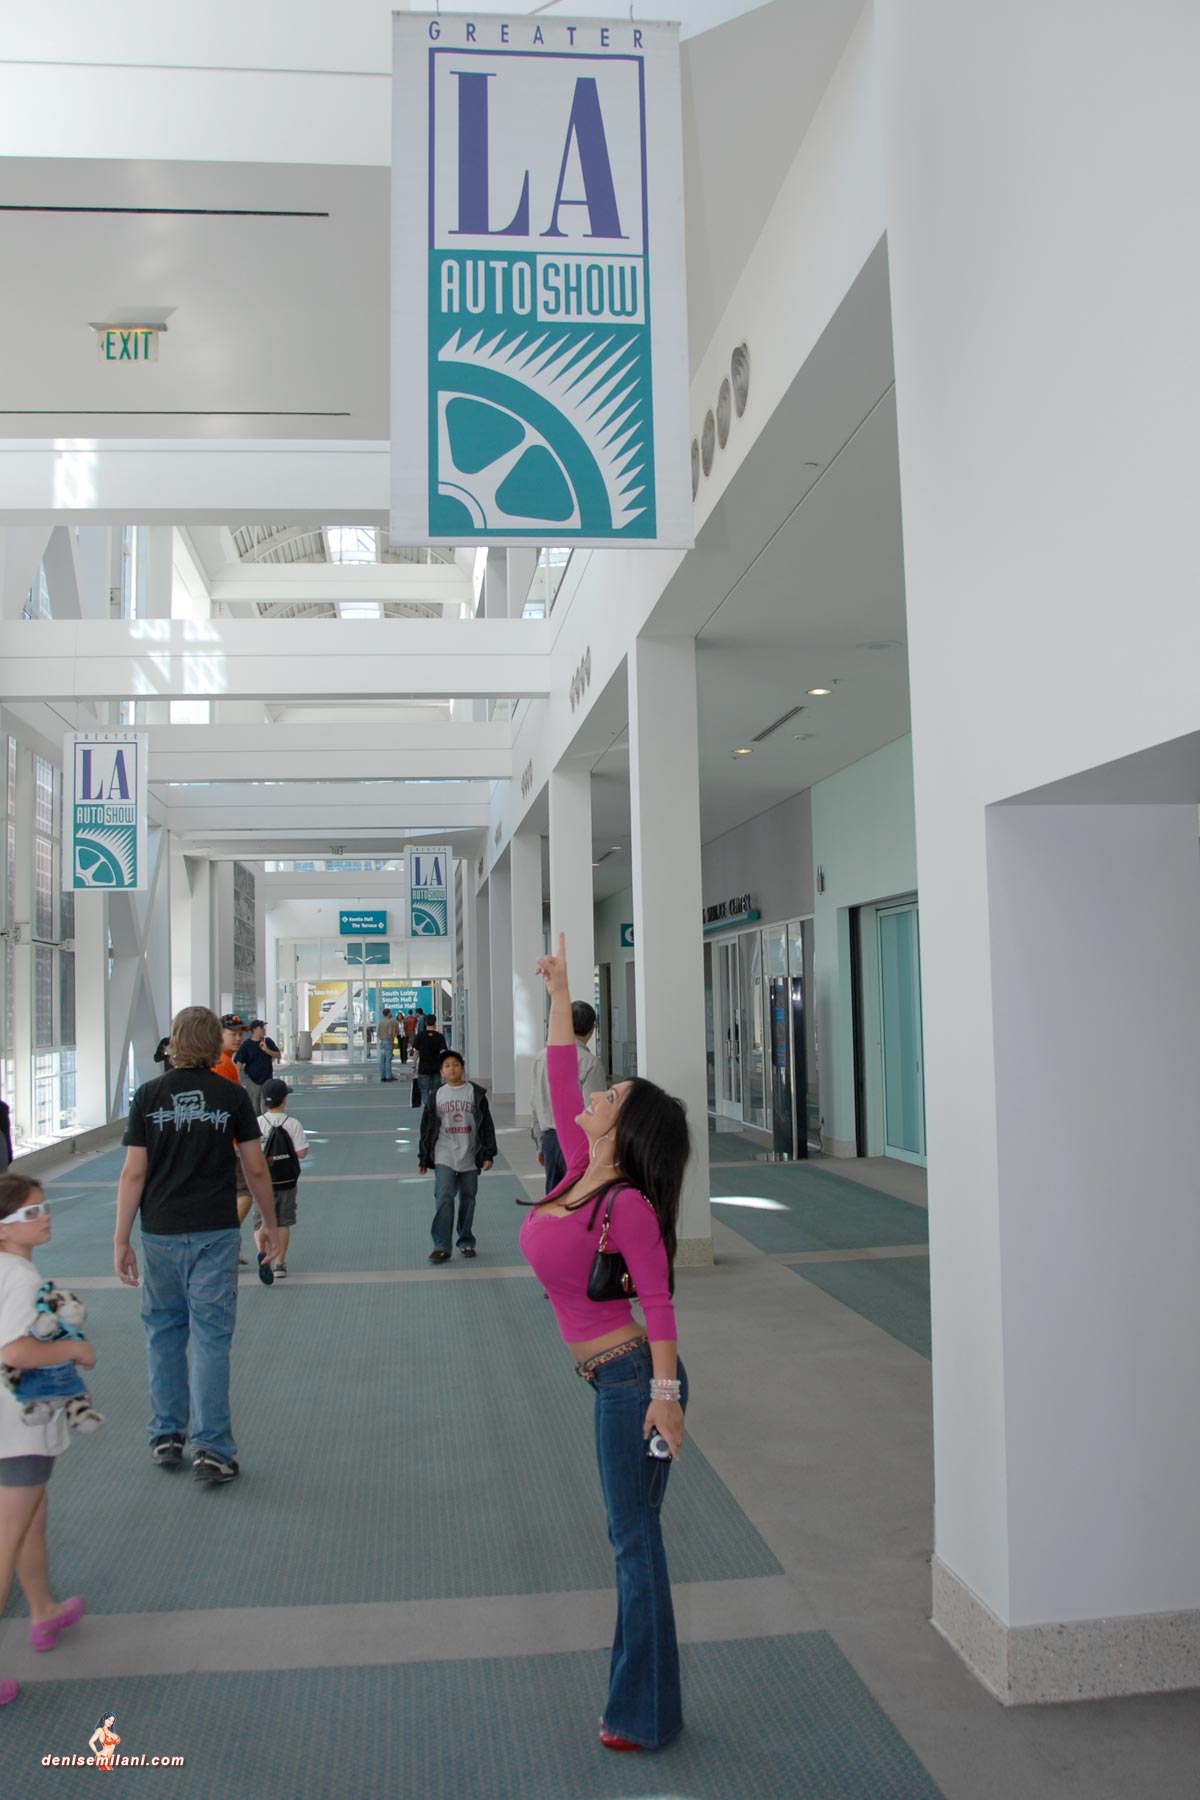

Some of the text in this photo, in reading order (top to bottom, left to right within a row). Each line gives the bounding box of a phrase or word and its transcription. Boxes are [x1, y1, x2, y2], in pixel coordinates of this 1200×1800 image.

[429, 21, 644, 49] GREATER
[448, 71, 630, 240] LA
[106, 331, 153, 360] EXIT
[80, 749, 131, 800] LA
[413, 856, 444, 887] LA
[400, 990, 418, 998] Lobby
